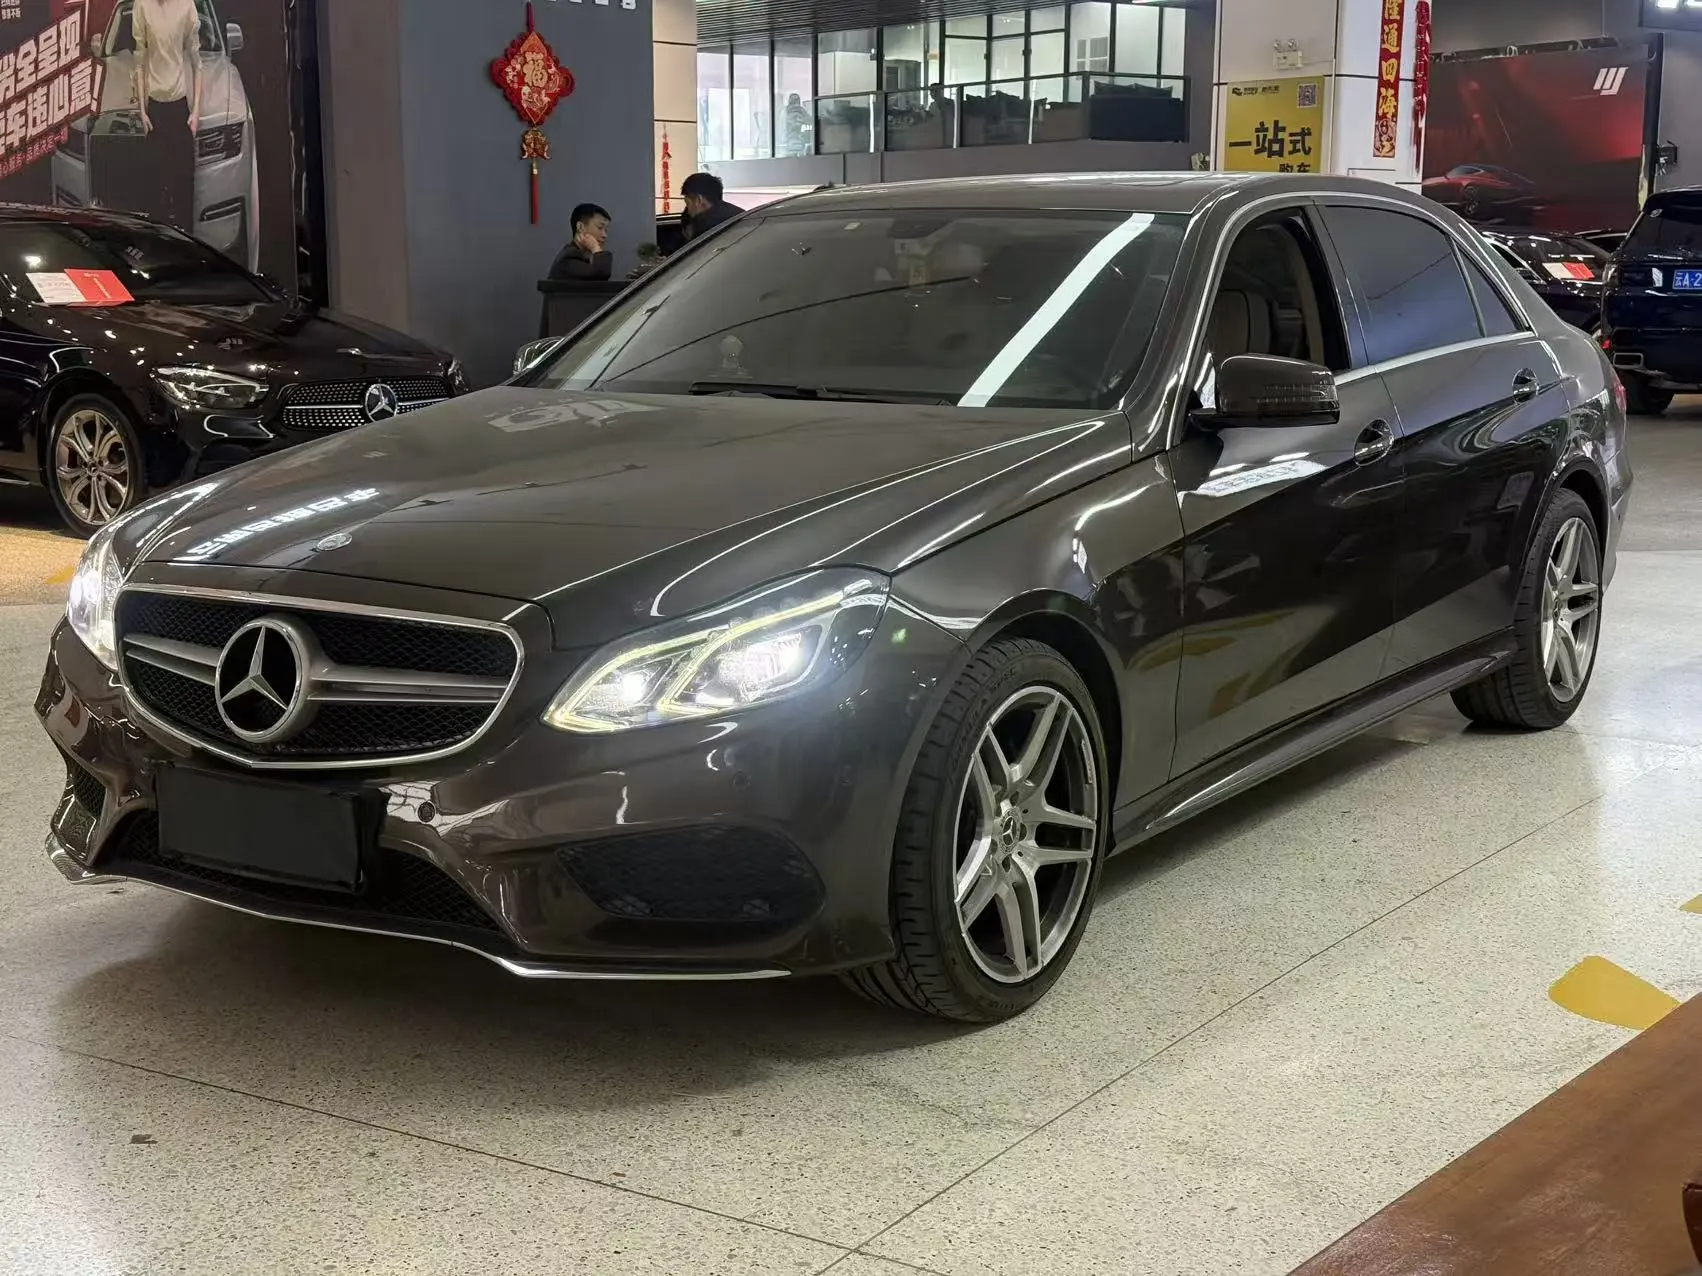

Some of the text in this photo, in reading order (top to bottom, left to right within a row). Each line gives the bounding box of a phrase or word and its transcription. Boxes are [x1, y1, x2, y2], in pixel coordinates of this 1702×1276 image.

[522, 51, 548, 87] 福
[0, 59, 103, 155] 车违心意!
[1228, 120, 1312, 158] 一站式
